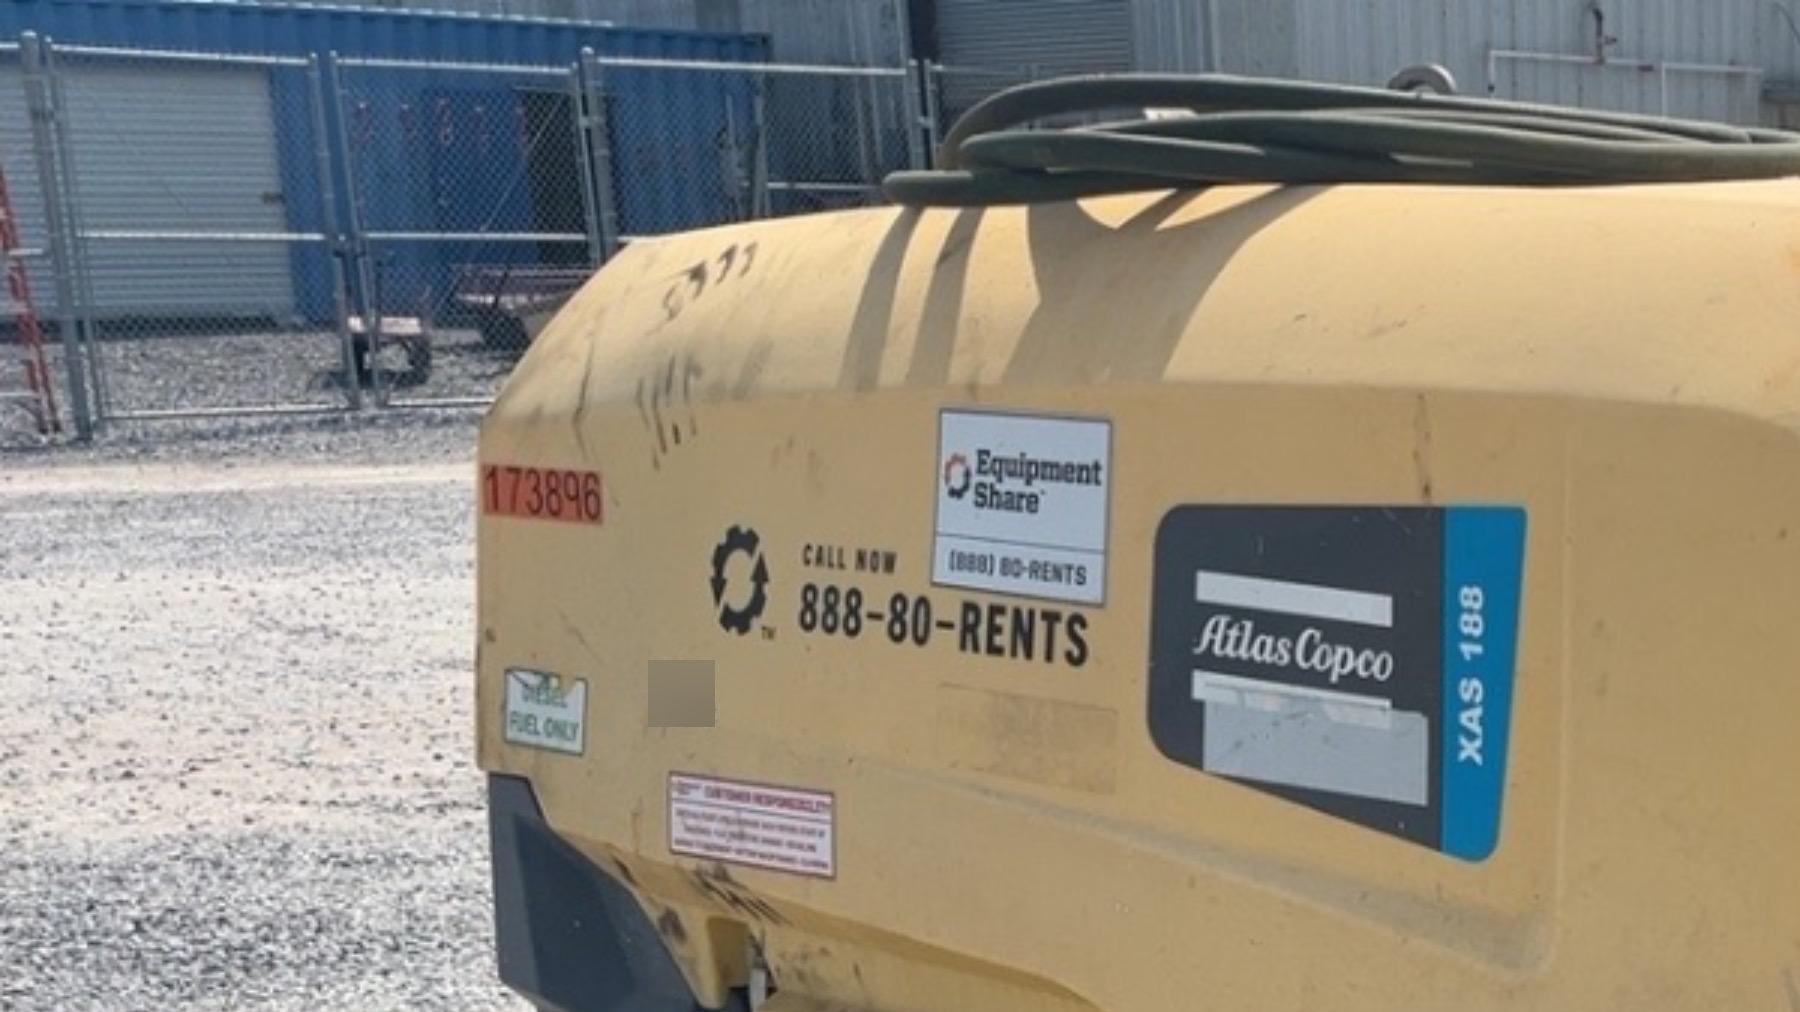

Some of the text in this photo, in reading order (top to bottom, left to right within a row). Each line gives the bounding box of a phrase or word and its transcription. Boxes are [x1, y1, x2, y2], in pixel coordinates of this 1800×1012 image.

[976, 449, 1102, 486] Equipment
[485, 466, 601, 520] 173896
[973, 482, 1040, 515] Share
[803, 544, 897, 574] CALL NOW
[950, 551, 1088, 587] (888) 80-RENTS
[799, 583, 1089, 668] 888-80-RENTS
[1193, 614, 1394, 684] Atlas Copco
[1458, 585, 1485, 766] XAS 188
[510, 710, 580, 742] FUEL ONLY
